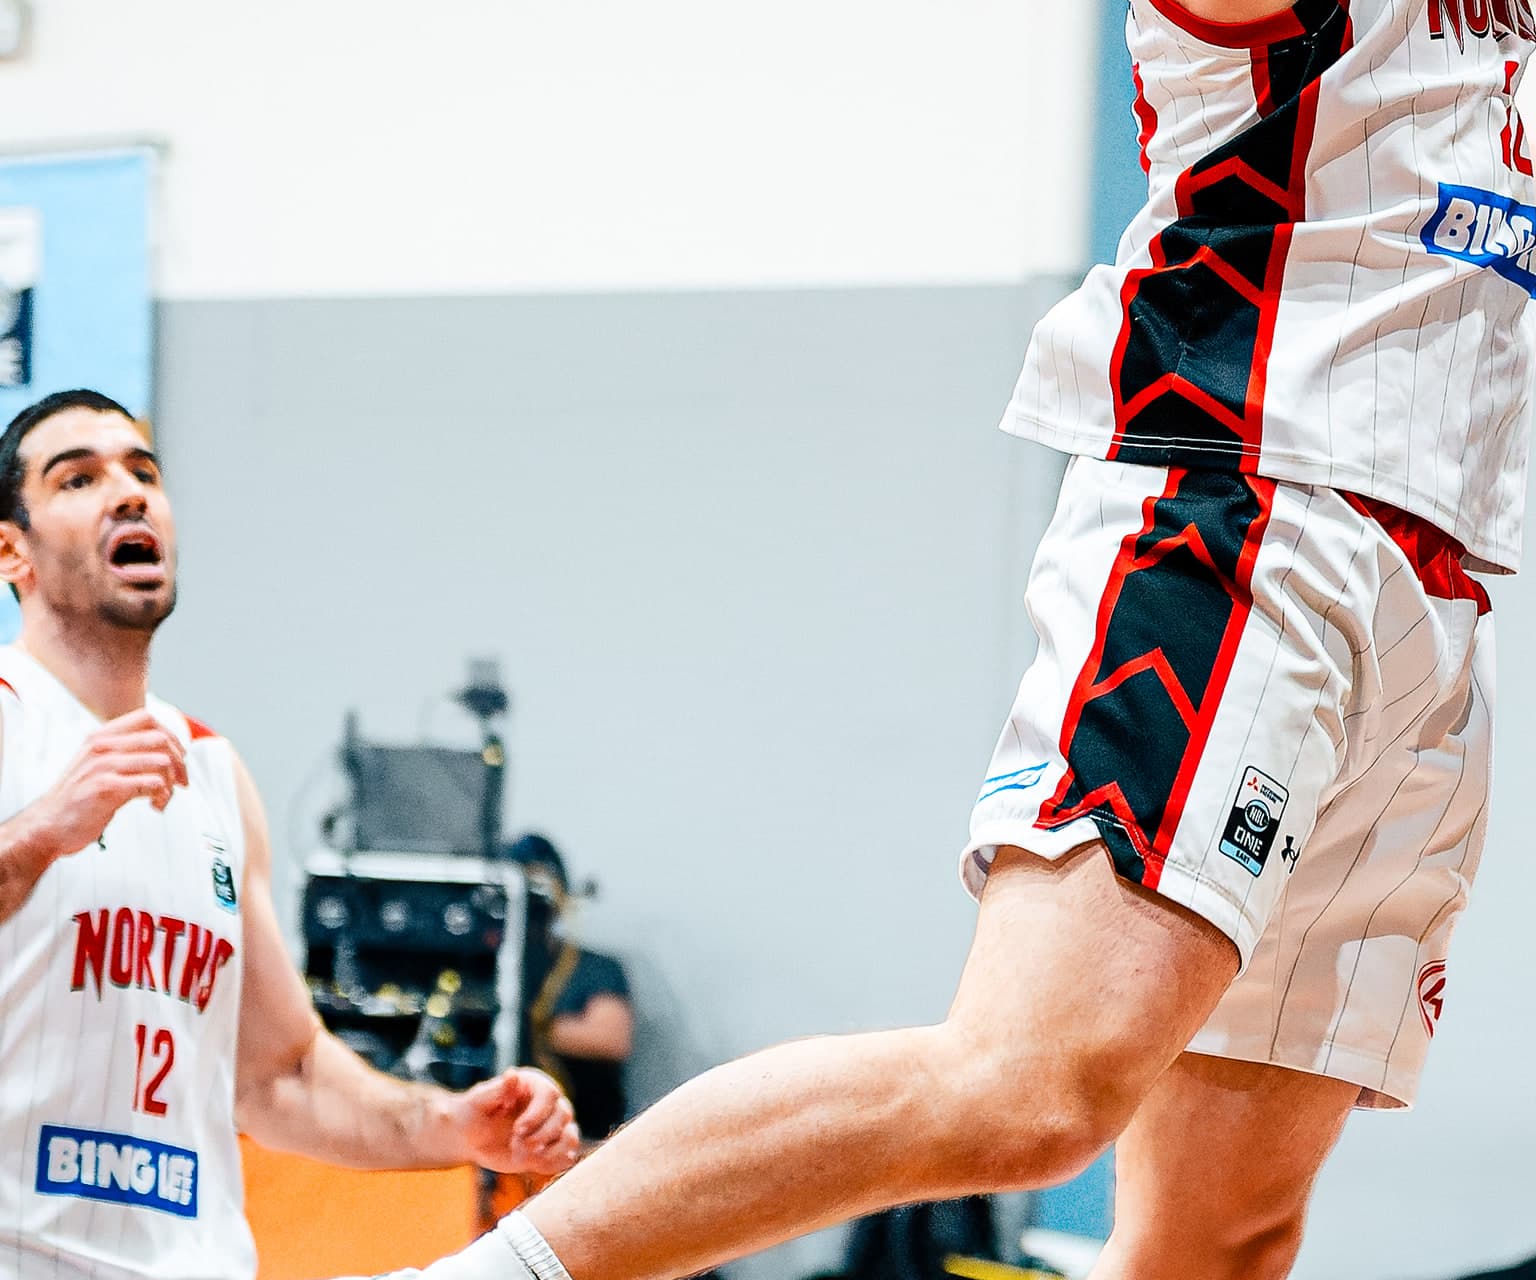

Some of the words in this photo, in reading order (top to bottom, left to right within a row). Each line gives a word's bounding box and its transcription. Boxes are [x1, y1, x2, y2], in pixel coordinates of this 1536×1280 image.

[1233, 825, 1264, 857] ONE
[70, 906, 235, 1014] NORTHS
[132, 1024, 176, 1117] 12
[47, 1136, 156, 1195] BING
